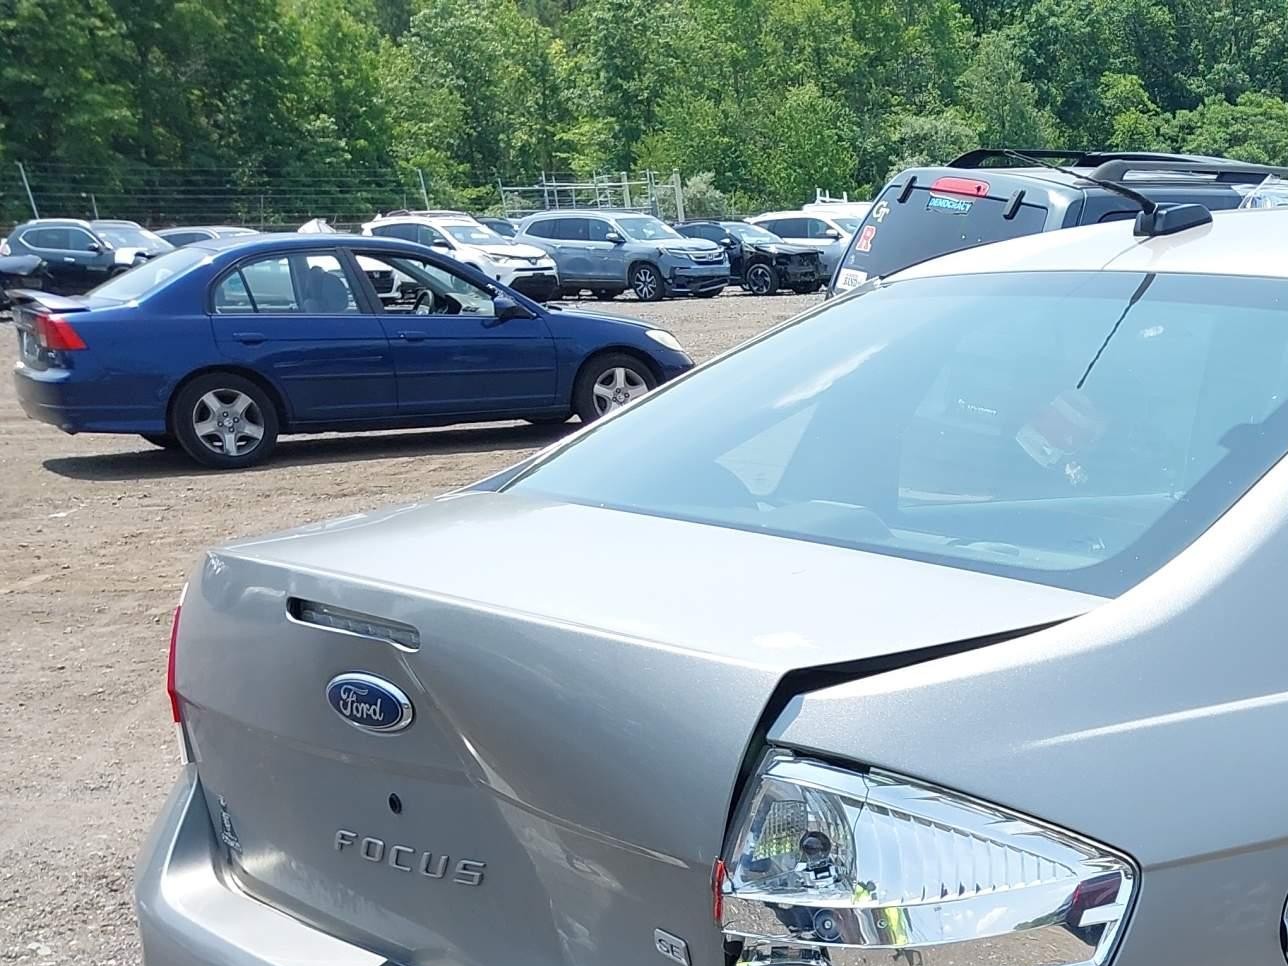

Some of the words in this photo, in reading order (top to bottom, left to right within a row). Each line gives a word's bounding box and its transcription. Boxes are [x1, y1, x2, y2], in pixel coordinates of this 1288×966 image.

[929, 198, 972, 211] DEMOCRACY
[856, 225, 876, 251] R
[340, 685, 384, 721] Ford
[334, 829, 487, 886] FOCUS
[658, 938, 682, 960] SE
